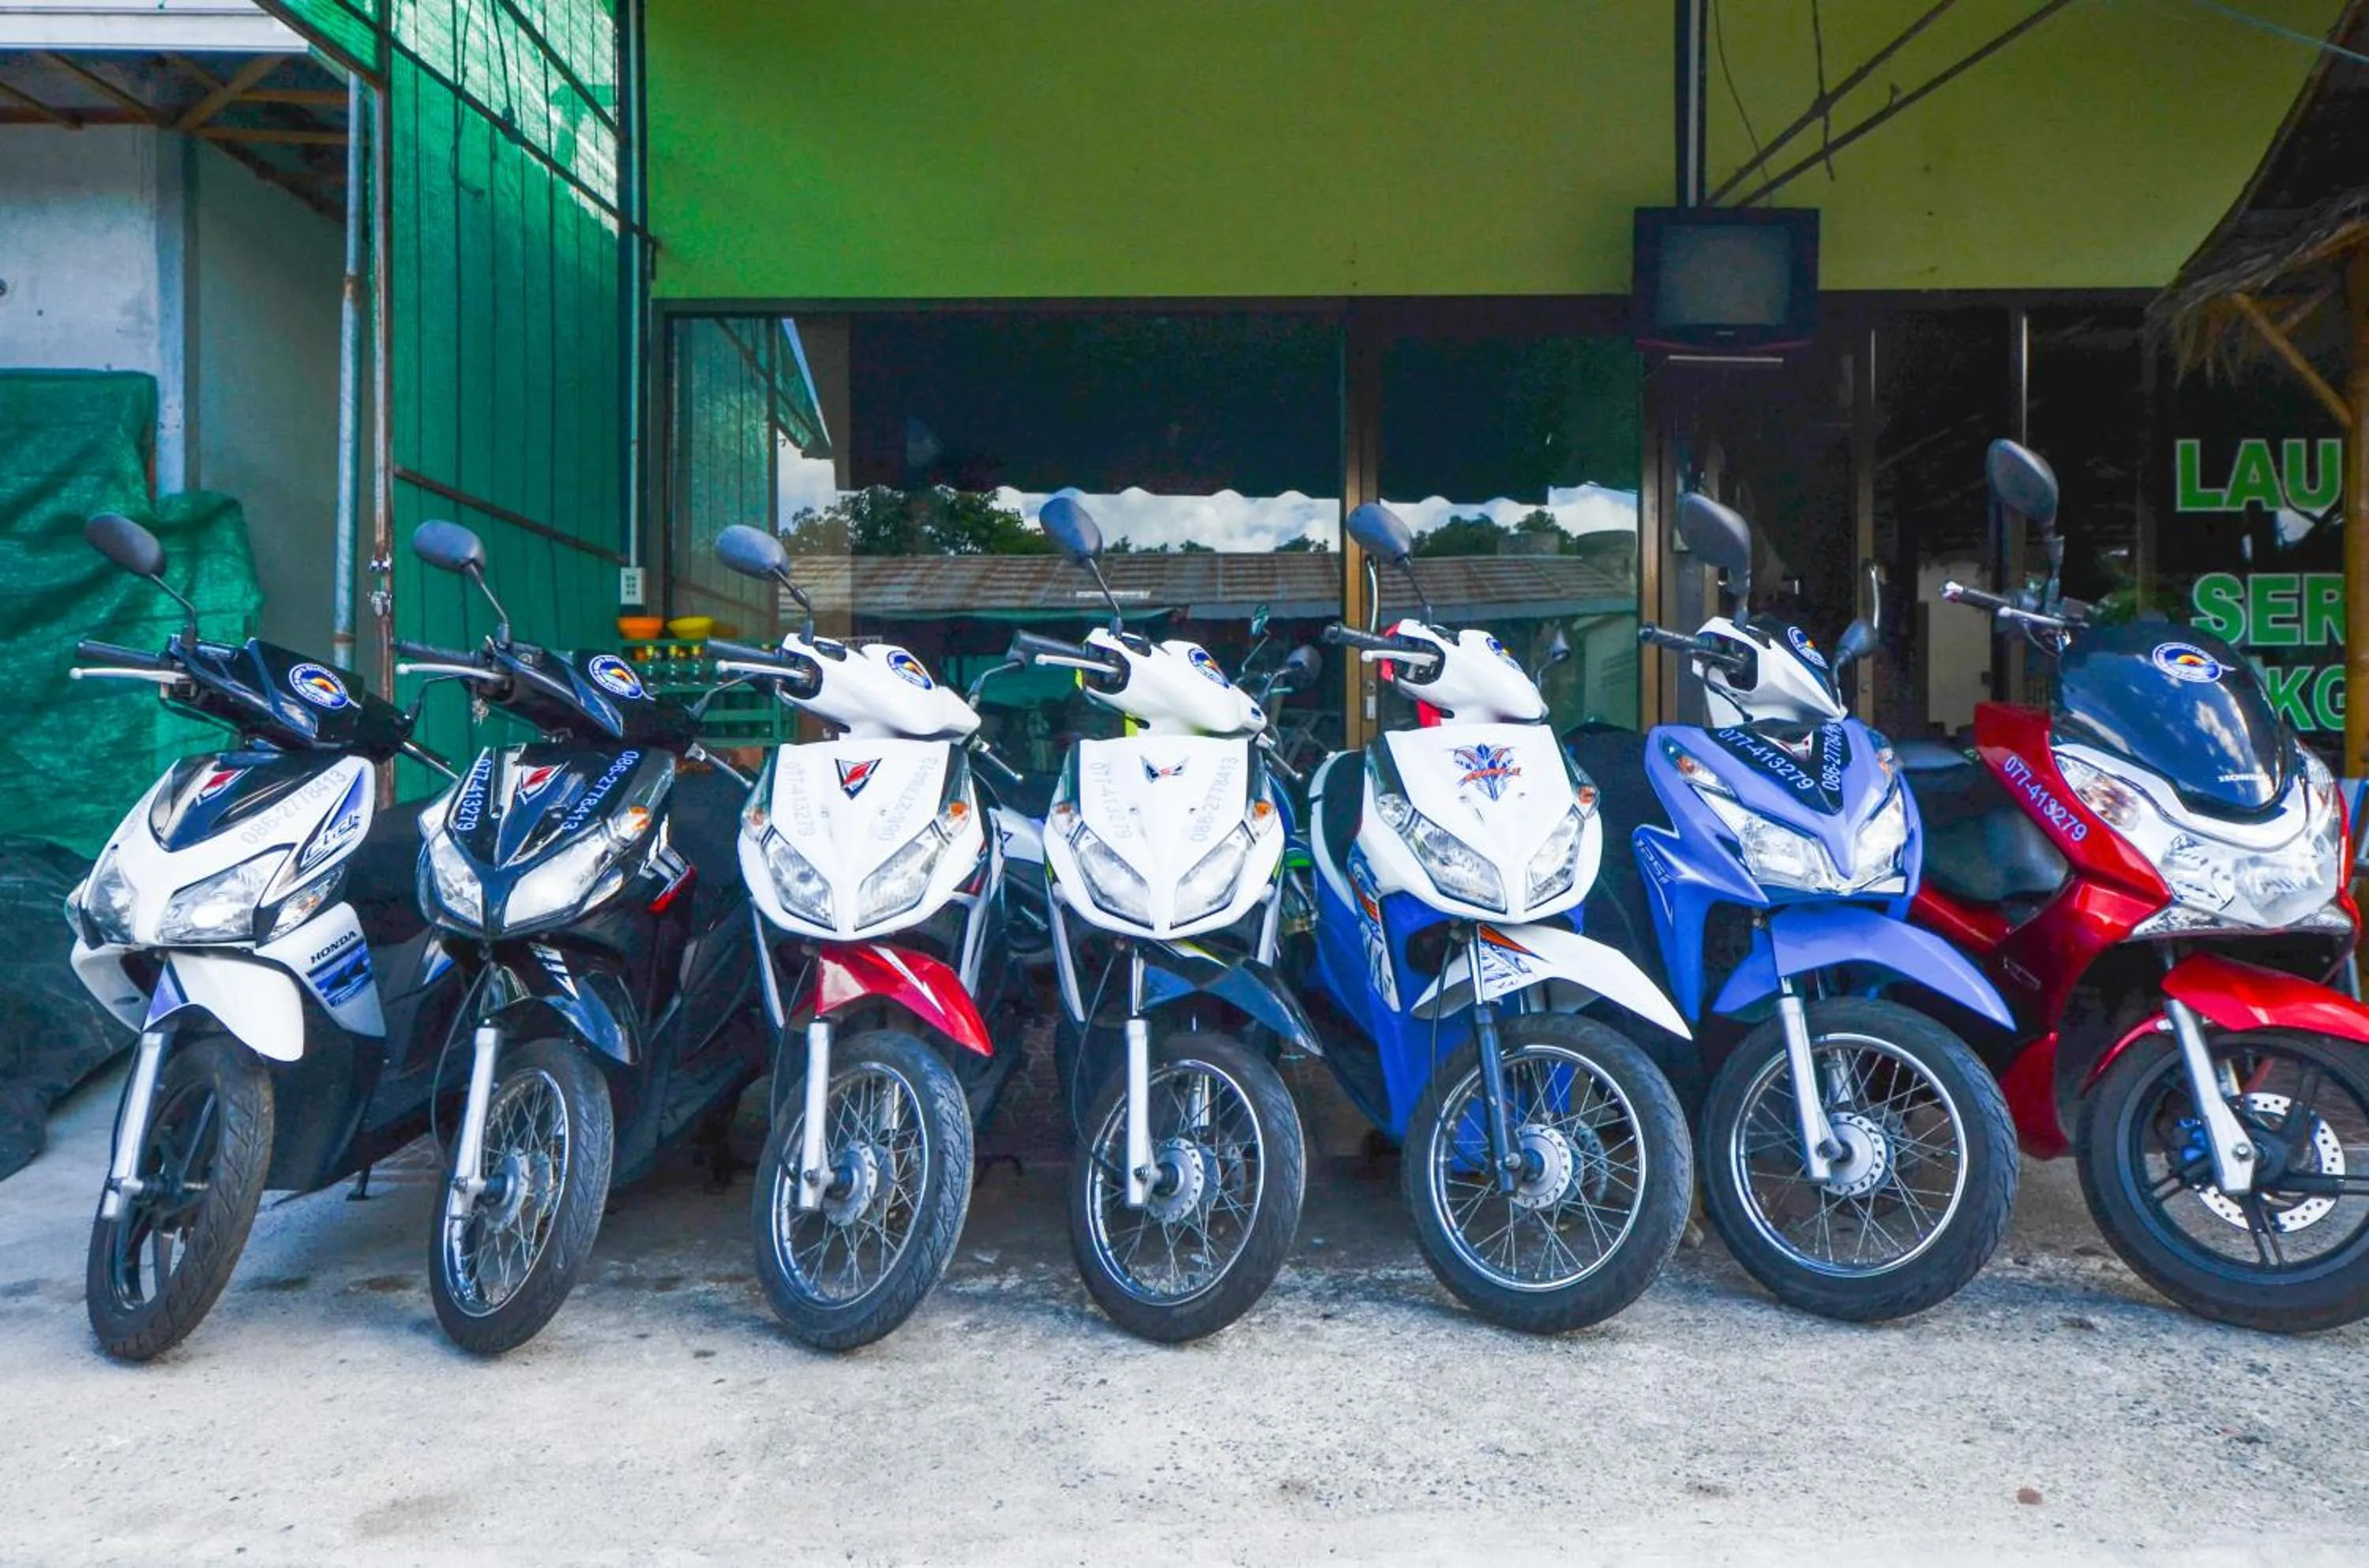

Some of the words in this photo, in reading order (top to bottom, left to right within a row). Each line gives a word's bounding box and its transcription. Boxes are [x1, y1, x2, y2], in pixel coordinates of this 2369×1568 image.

[2176, 438, 2343, 512] LAU
[2191, 572, 2345, 645] SER
[2266, 665, 2345, 731] KG
[456, 759, 492, 831] 077-413279
[561, 751, 640, 830] 086-2778413
[1718, 729, 1815, 790] 077-413279
[240, 770, 347, 845] 086-2778413
[2005, 756, 2087, 841] 077-413279
[310, 930, 357, 964] HONDA
